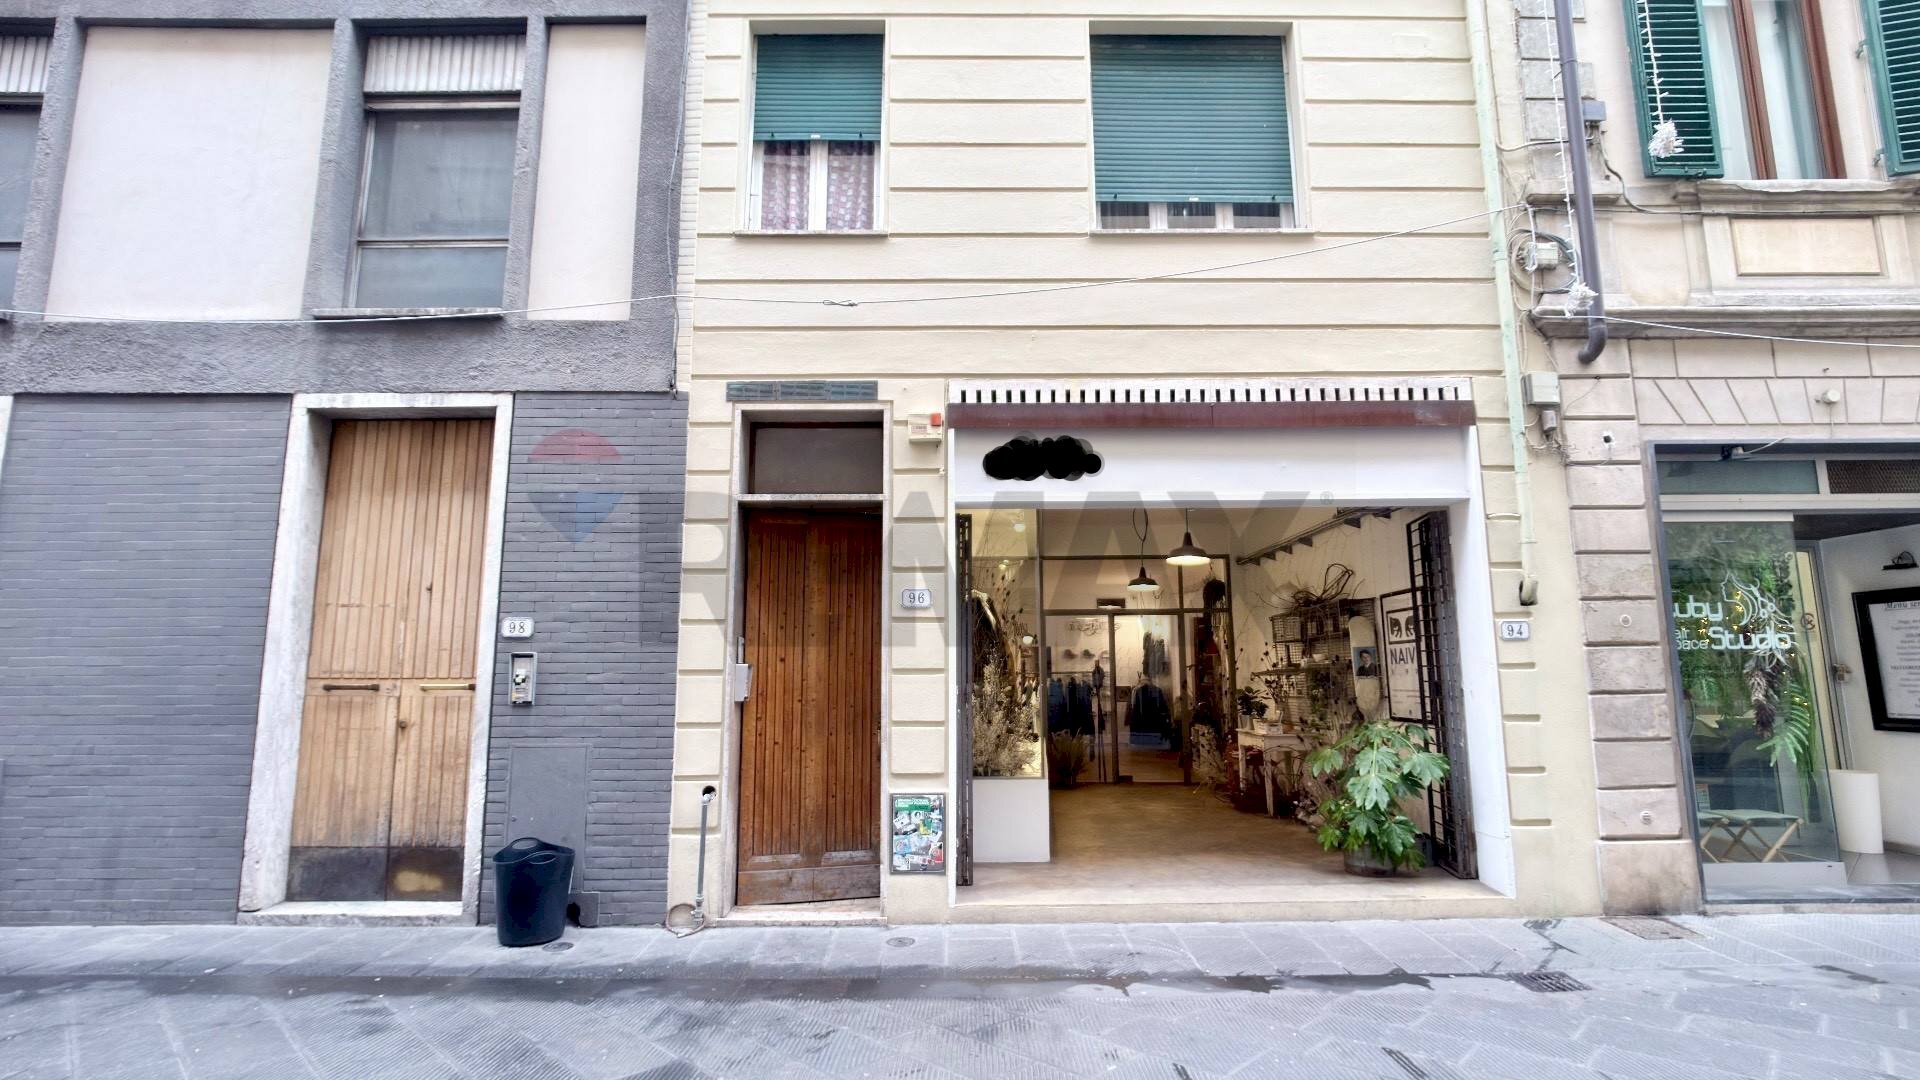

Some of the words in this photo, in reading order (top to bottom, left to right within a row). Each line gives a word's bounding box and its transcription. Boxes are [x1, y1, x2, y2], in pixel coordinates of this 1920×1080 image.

[908, 591, 925, 604] 96
[1674, 595, 1722, 621] uby
[508, 621, 526, 634] 98
[1506, 624, 1524, 637] 94
[1674, 627, 1689, 639] air
[1708, 626, 1791, 649] Studio
